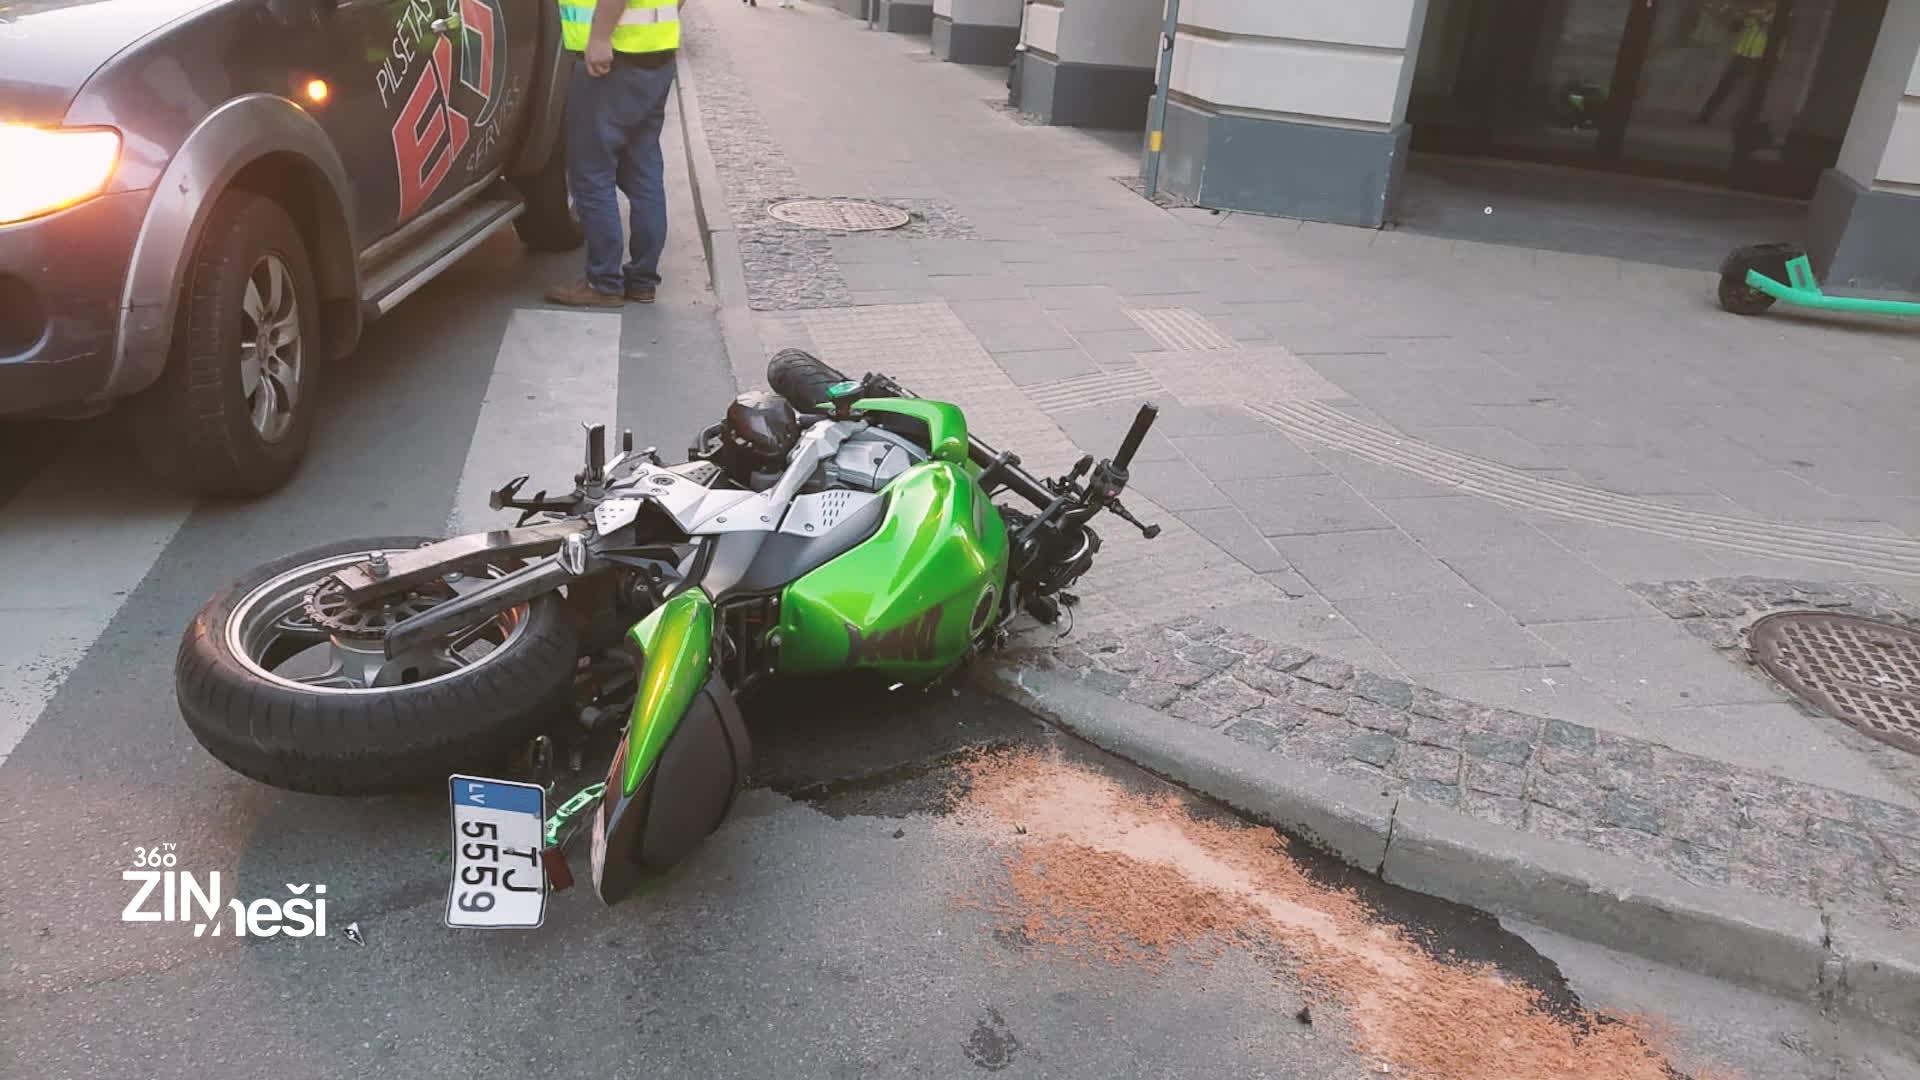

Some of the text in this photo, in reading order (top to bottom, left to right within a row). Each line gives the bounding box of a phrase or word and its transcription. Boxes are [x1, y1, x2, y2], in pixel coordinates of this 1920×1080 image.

[468, 783, 485, 804] LV
[458, 821, 498, 912] 5559
[502, 847, 541, 892] TJ
